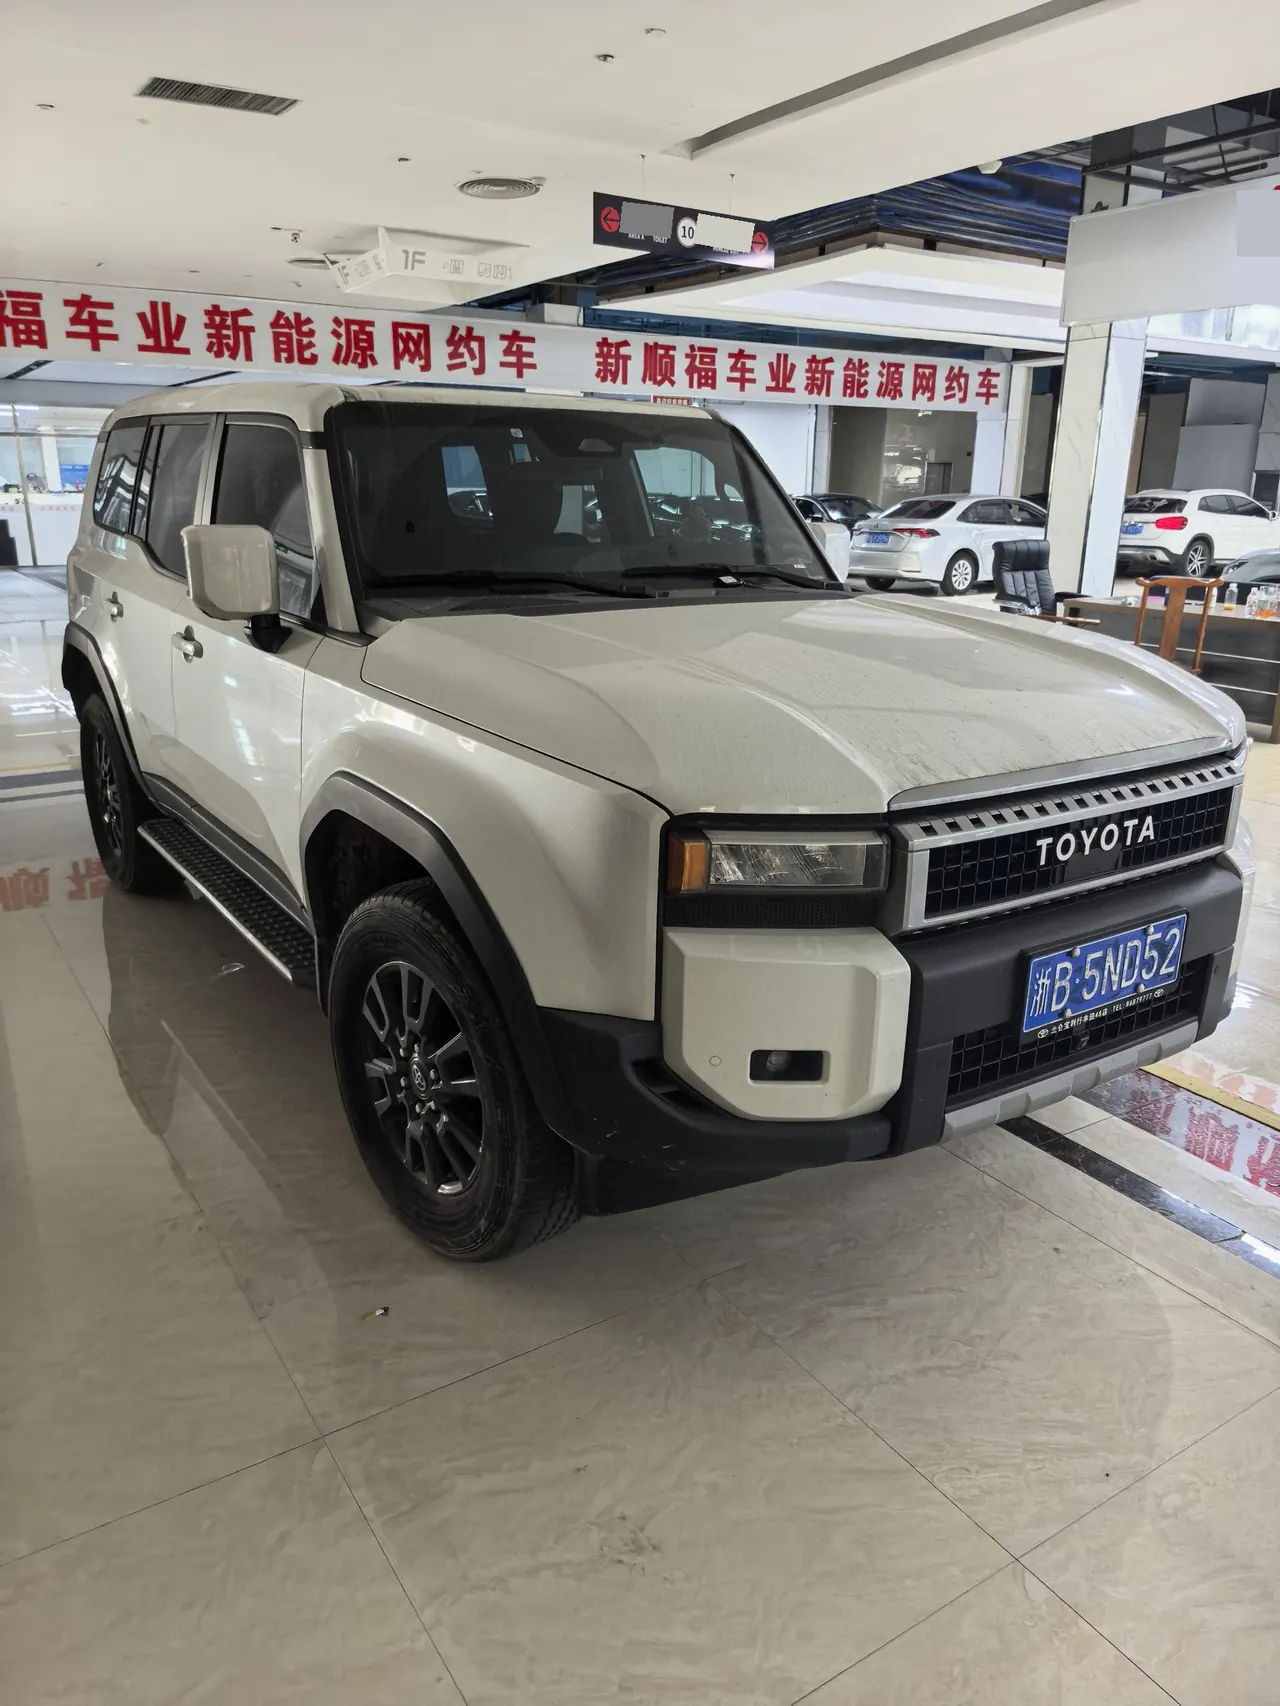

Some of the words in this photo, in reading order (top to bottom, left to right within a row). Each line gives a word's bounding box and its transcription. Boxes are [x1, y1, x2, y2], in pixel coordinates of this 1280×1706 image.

[653, 236, 668, 244] TOILET
[681, 226, 695, 239] 10
[402, 249, 426, 271] 1F
[0, 290, 538, 378] 福车业新能源网约车
[595, 337, 1001, 405] 新顺福车业新能源网约车
[1036, 816, 1155, 866] TOYOTA
